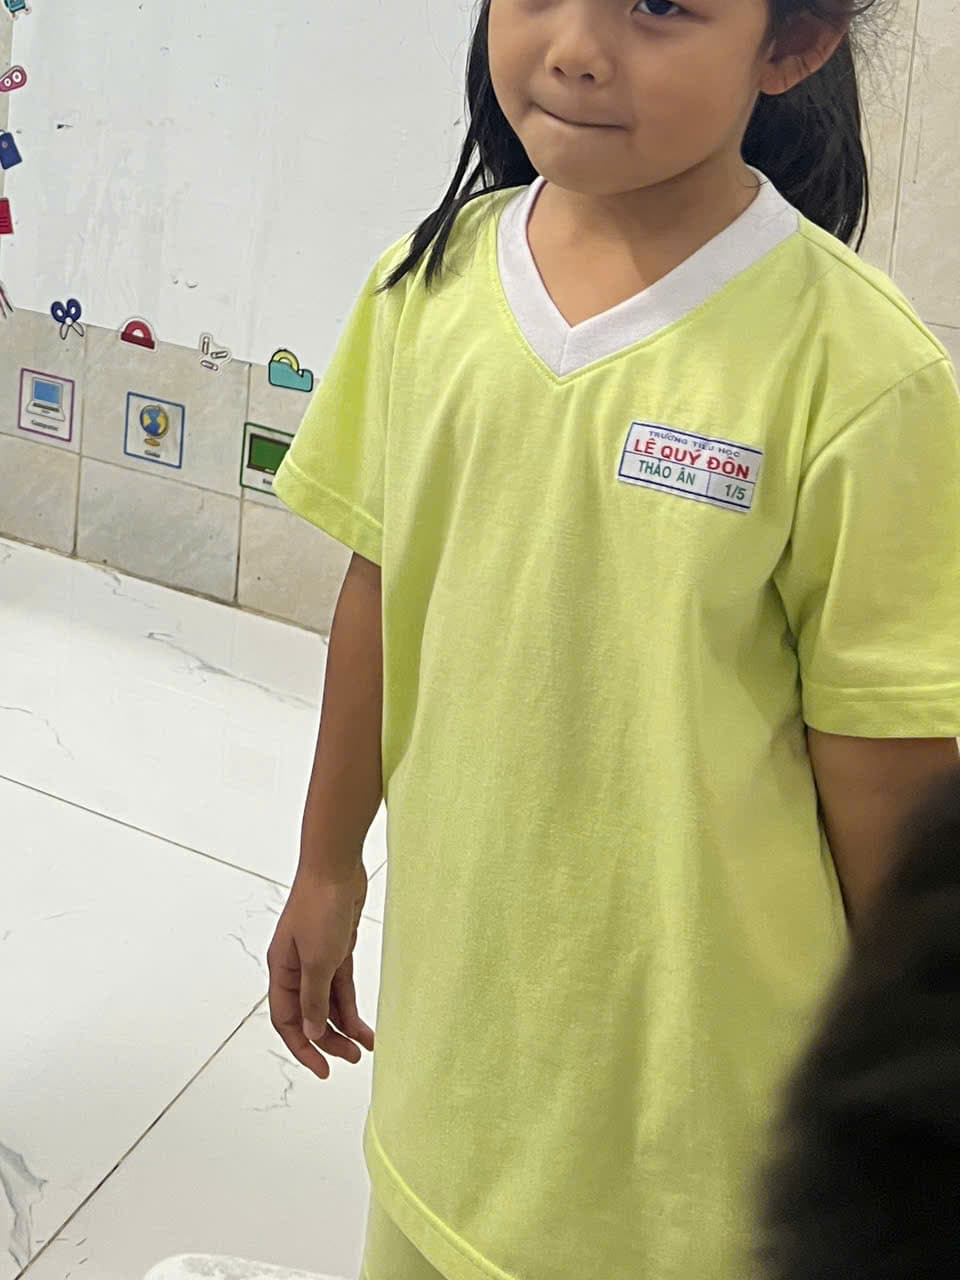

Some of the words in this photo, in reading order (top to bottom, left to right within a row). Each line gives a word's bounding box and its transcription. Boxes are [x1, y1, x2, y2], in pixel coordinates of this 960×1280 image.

[633, 437, 657, 455] LÊ
[660, 444, 702, 466] QUÝ
[706, 455, 750, 480] ĐÔN
[724, 483, 747, 501] 1/5
